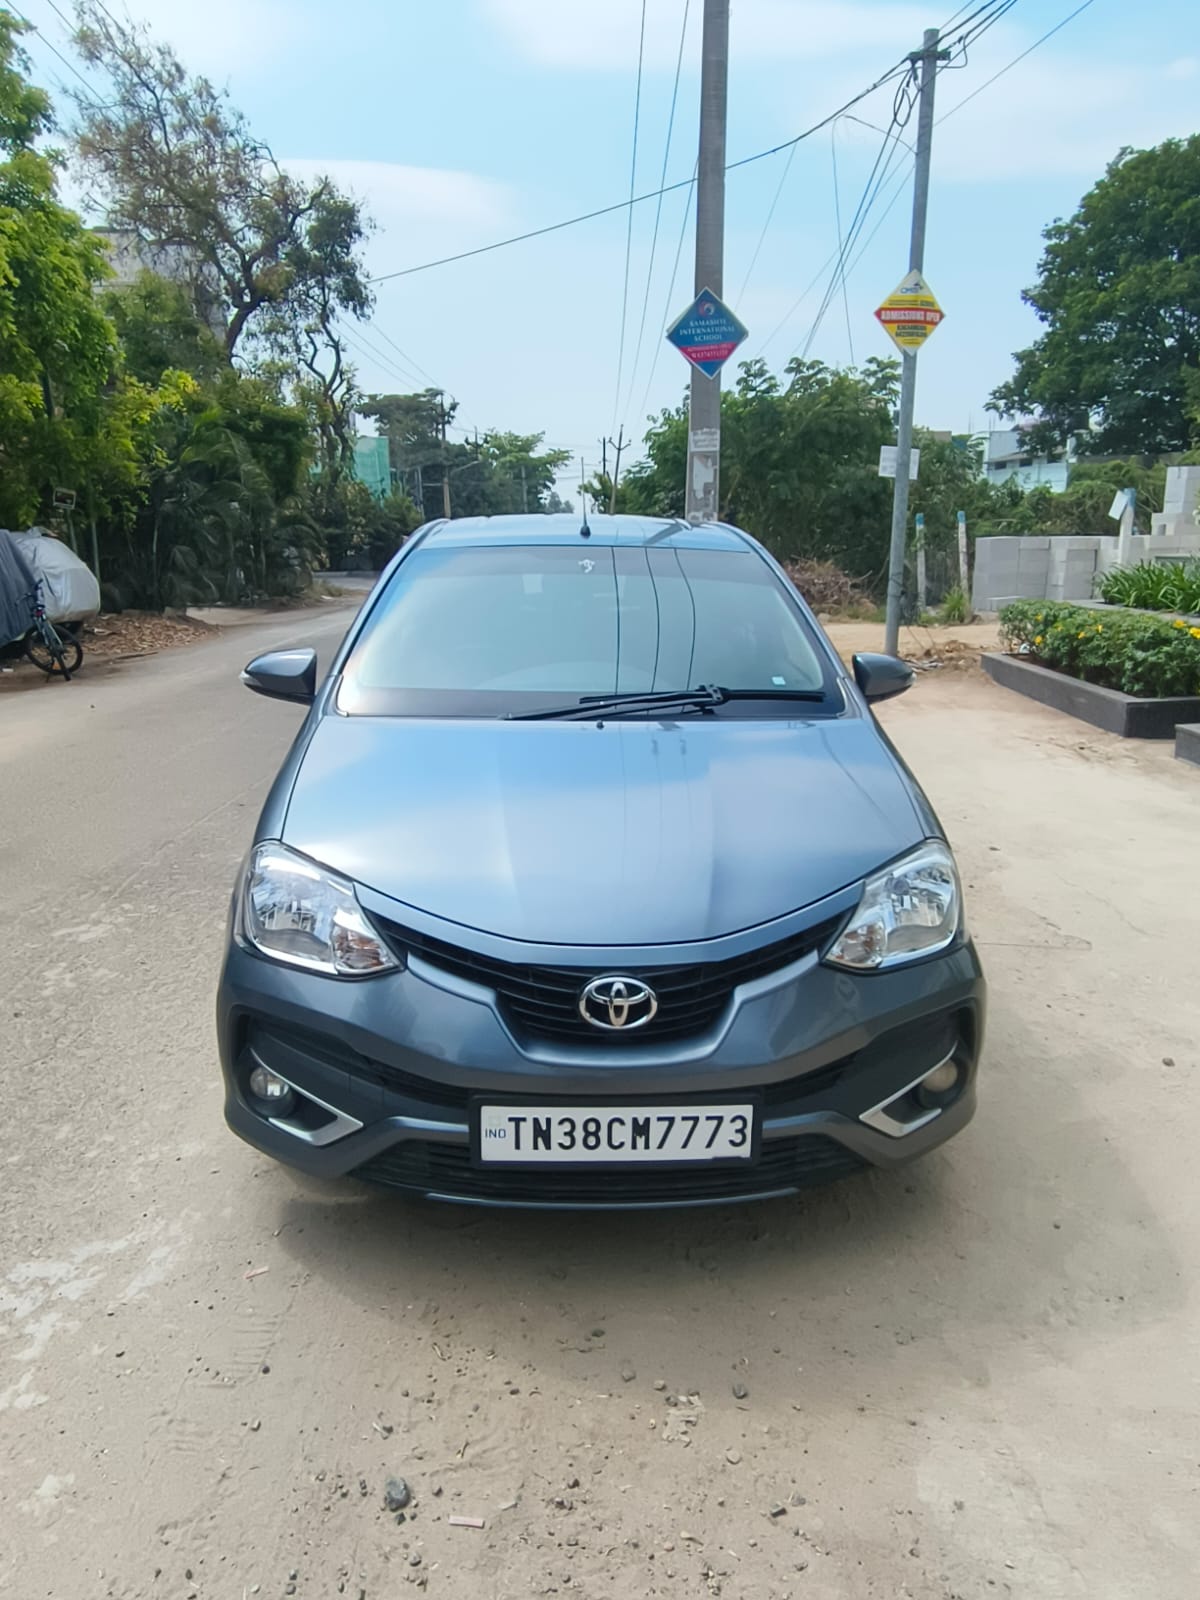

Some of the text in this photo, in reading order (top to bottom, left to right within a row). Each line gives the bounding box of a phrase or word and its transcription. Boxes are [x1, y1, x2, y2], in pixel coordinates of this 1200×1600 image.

[680, 325, 735, 336] INTERNATIONAL
[694, 334, 722, 342] SCHOOL
[484, 1115, 748, 1150] IND TN38CM7773
